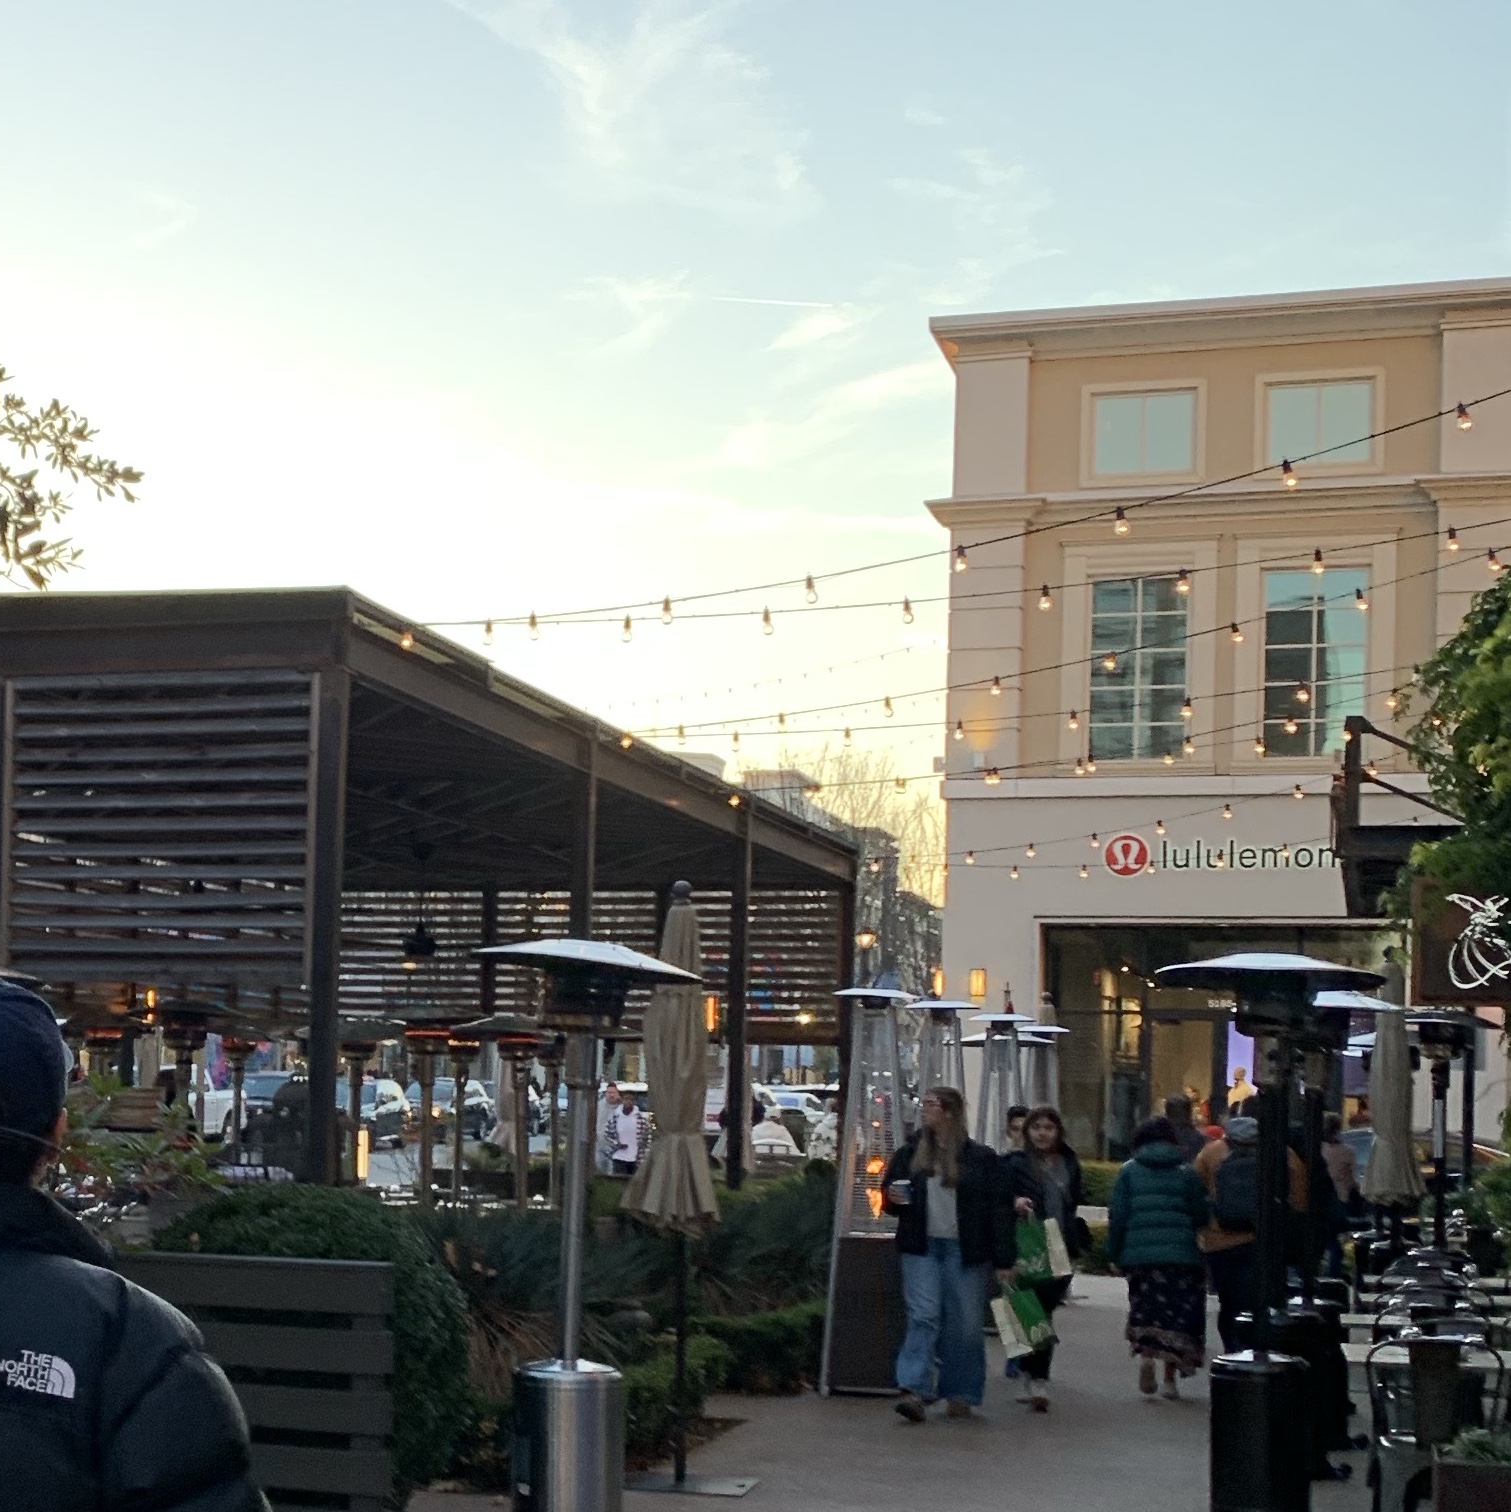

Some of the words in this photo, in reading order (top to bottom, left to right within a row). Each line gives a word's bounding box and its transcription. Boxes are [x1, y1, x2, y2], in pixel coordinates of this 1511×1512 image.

[1162, 840, 1336, 868] lululemon
[21, 1350, 52, 1367] THE
[7, 1374, 48, 1393] FACE
